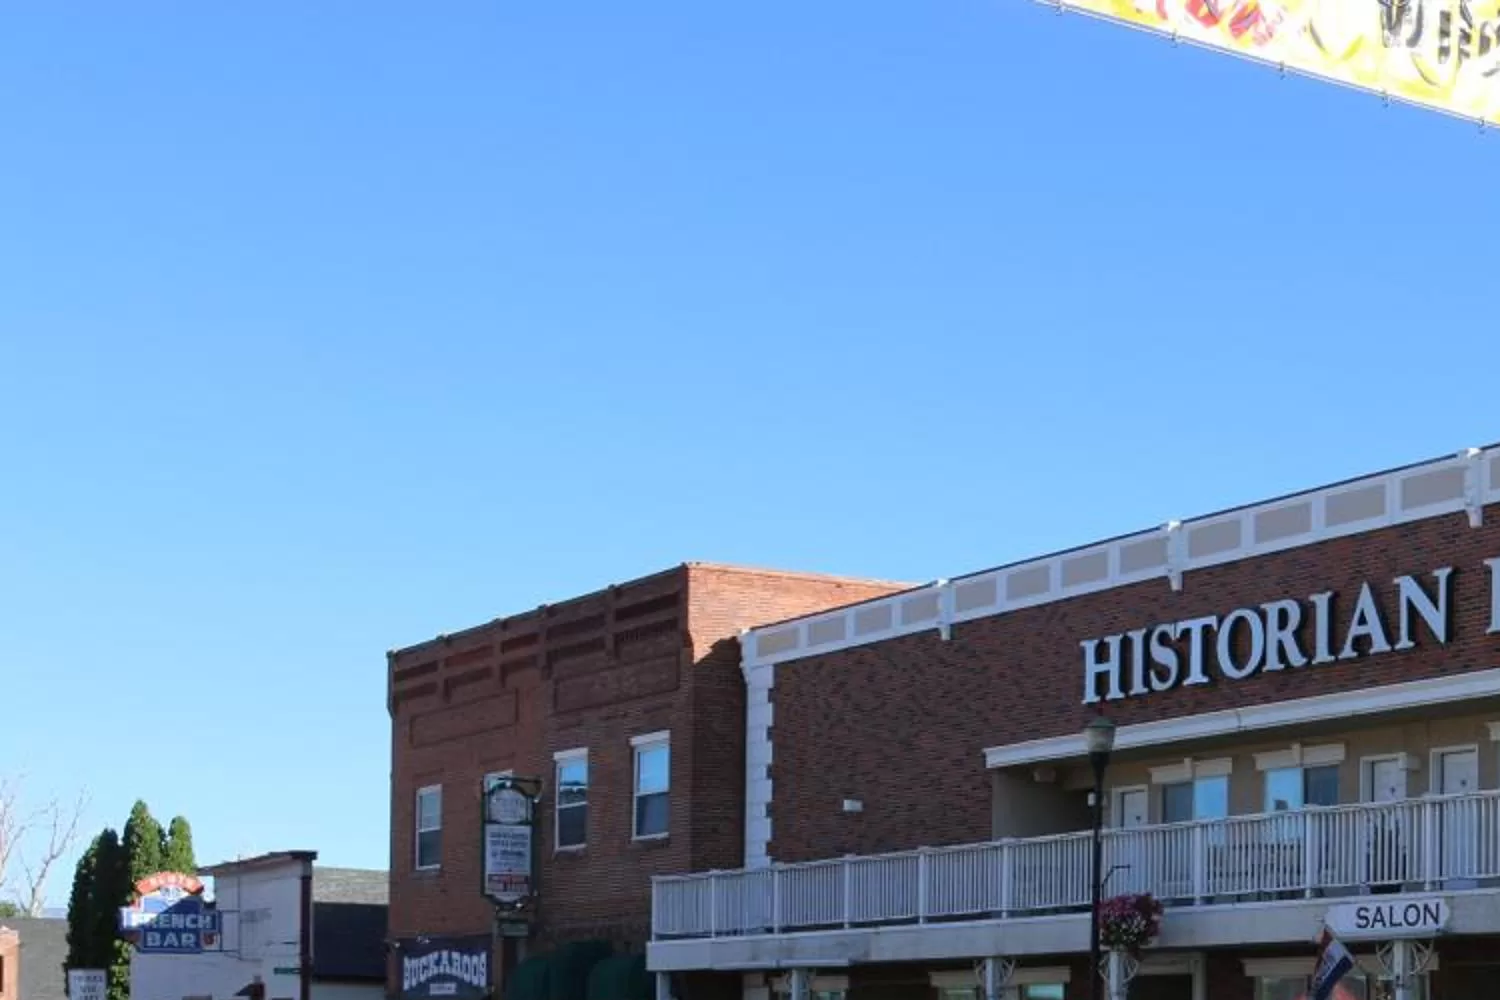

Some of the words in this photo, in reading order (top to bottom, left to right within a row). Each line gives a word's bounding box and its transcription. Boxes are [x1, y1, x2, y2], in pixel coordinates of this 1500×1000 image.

[1079, 566, 1454, 704] HISTORIAN
[1355, 902, 1440, 929] SALON
[146, 931, 198, 948] BAR
[403, 949, 488, 991] BUCKAROOS
